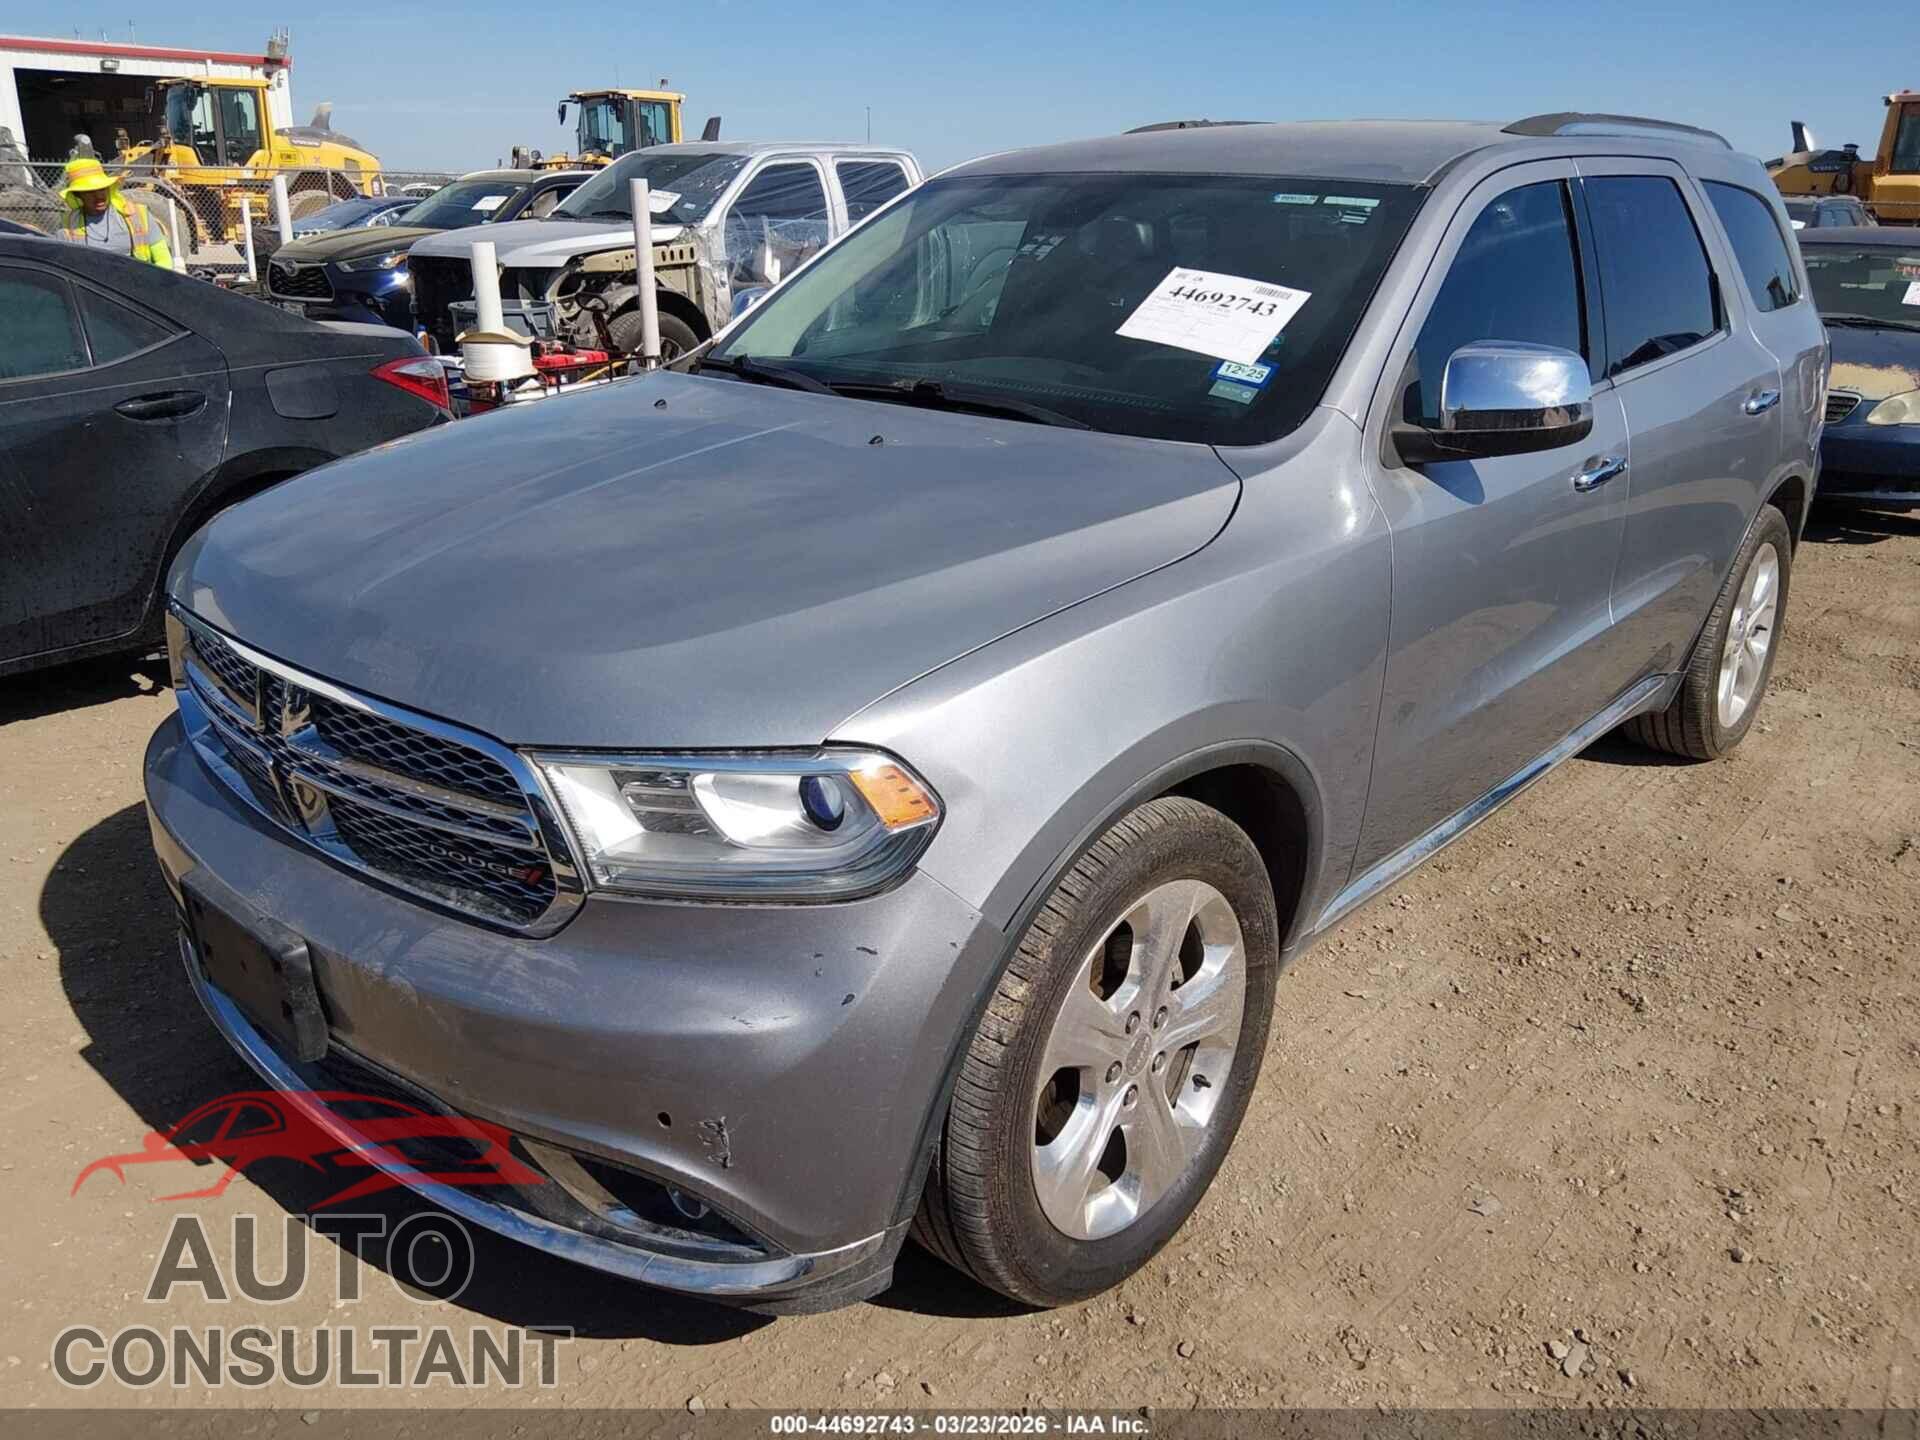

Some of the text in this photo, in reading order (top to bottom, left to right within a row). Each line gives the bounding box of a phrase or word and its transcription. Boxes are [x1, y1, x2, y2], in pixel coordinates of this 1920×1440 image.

[1169, 285, 1278, 317] 44692743
[1224, 363, 1242, 375] 12
[1246, 368, 1267, 380] 25
[430, 844, 527, 880] DODGE
